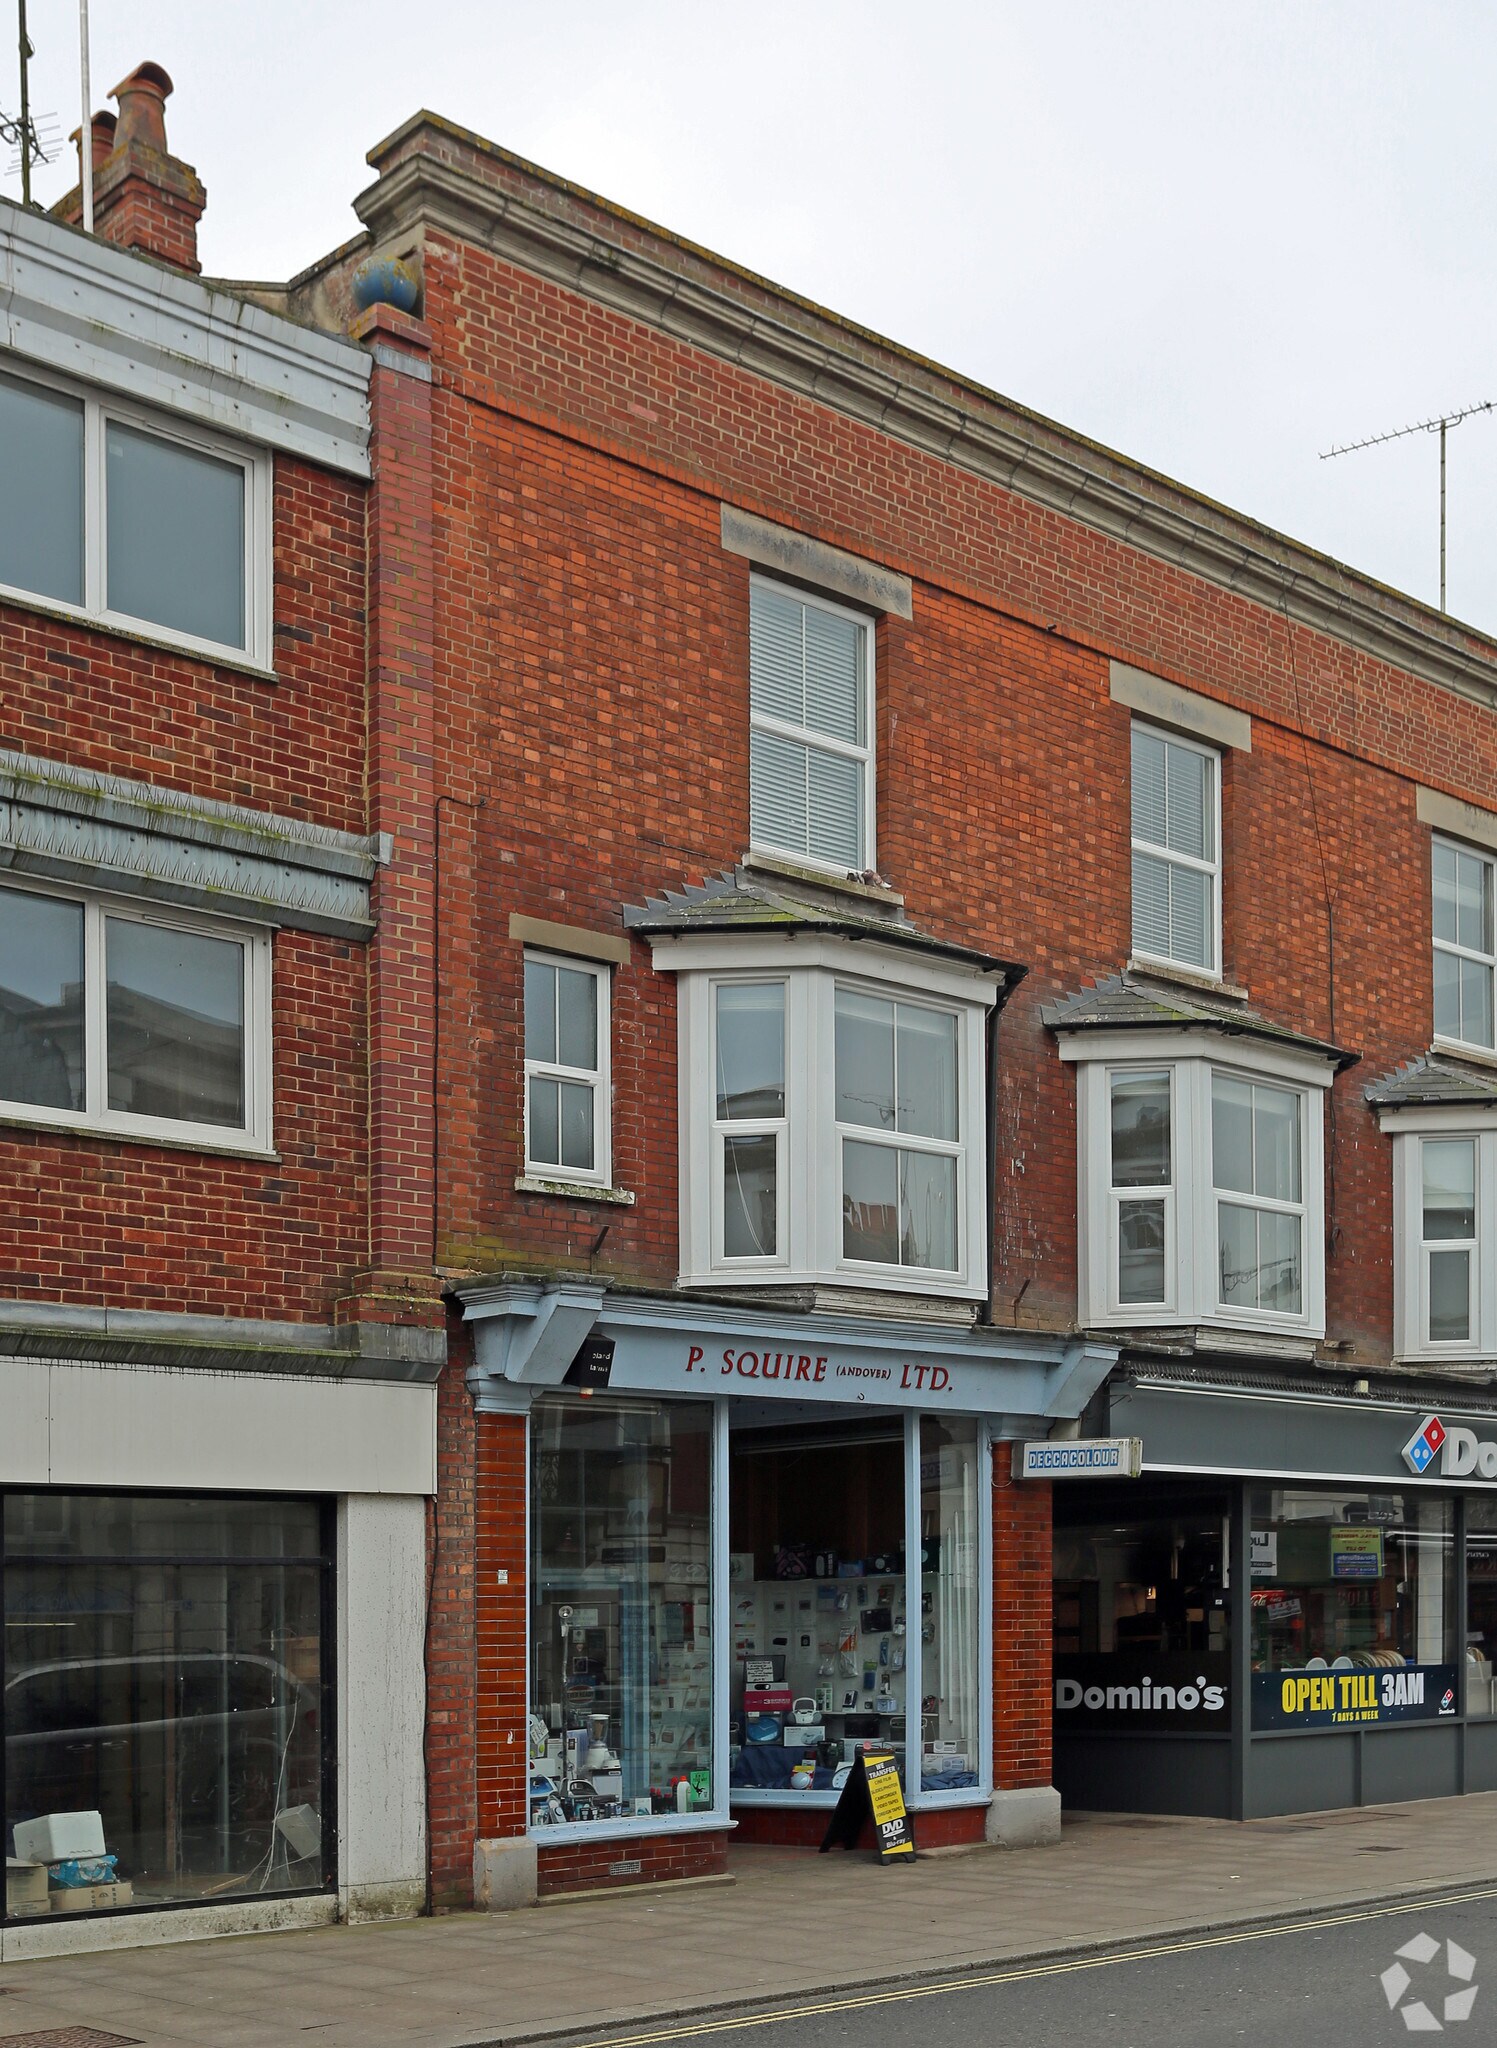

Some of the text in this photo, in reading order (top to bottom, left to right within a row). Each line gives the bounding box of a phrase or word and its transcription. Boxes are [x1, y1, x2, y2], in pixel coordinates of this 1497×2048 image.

[685, 1346, 953, 1392] P. SQUIRE (ANDOVER) LTD.
[1028, 1449, 1119, 1469] DECCACOLOUR
[1056, 1676, 1225, 1711] Domino's
[1281, 1672, 1425, 1713] OPEN TILL 3AM
[1337, 1711, 1354, 1722] DAYS
[1354, 1711, 1360, 1721] A
[1361, 1710, 1379, 1720] WEEK
[868, 1765, 896, 1779] TRANSFER
[875, 1762, 885, 1770] WE
[875, 1791, 897, 1801] CAMCORDER
[881, 1819, 904, 1834] DVD
[886, 1838, 906, 1848] Blu-ray
